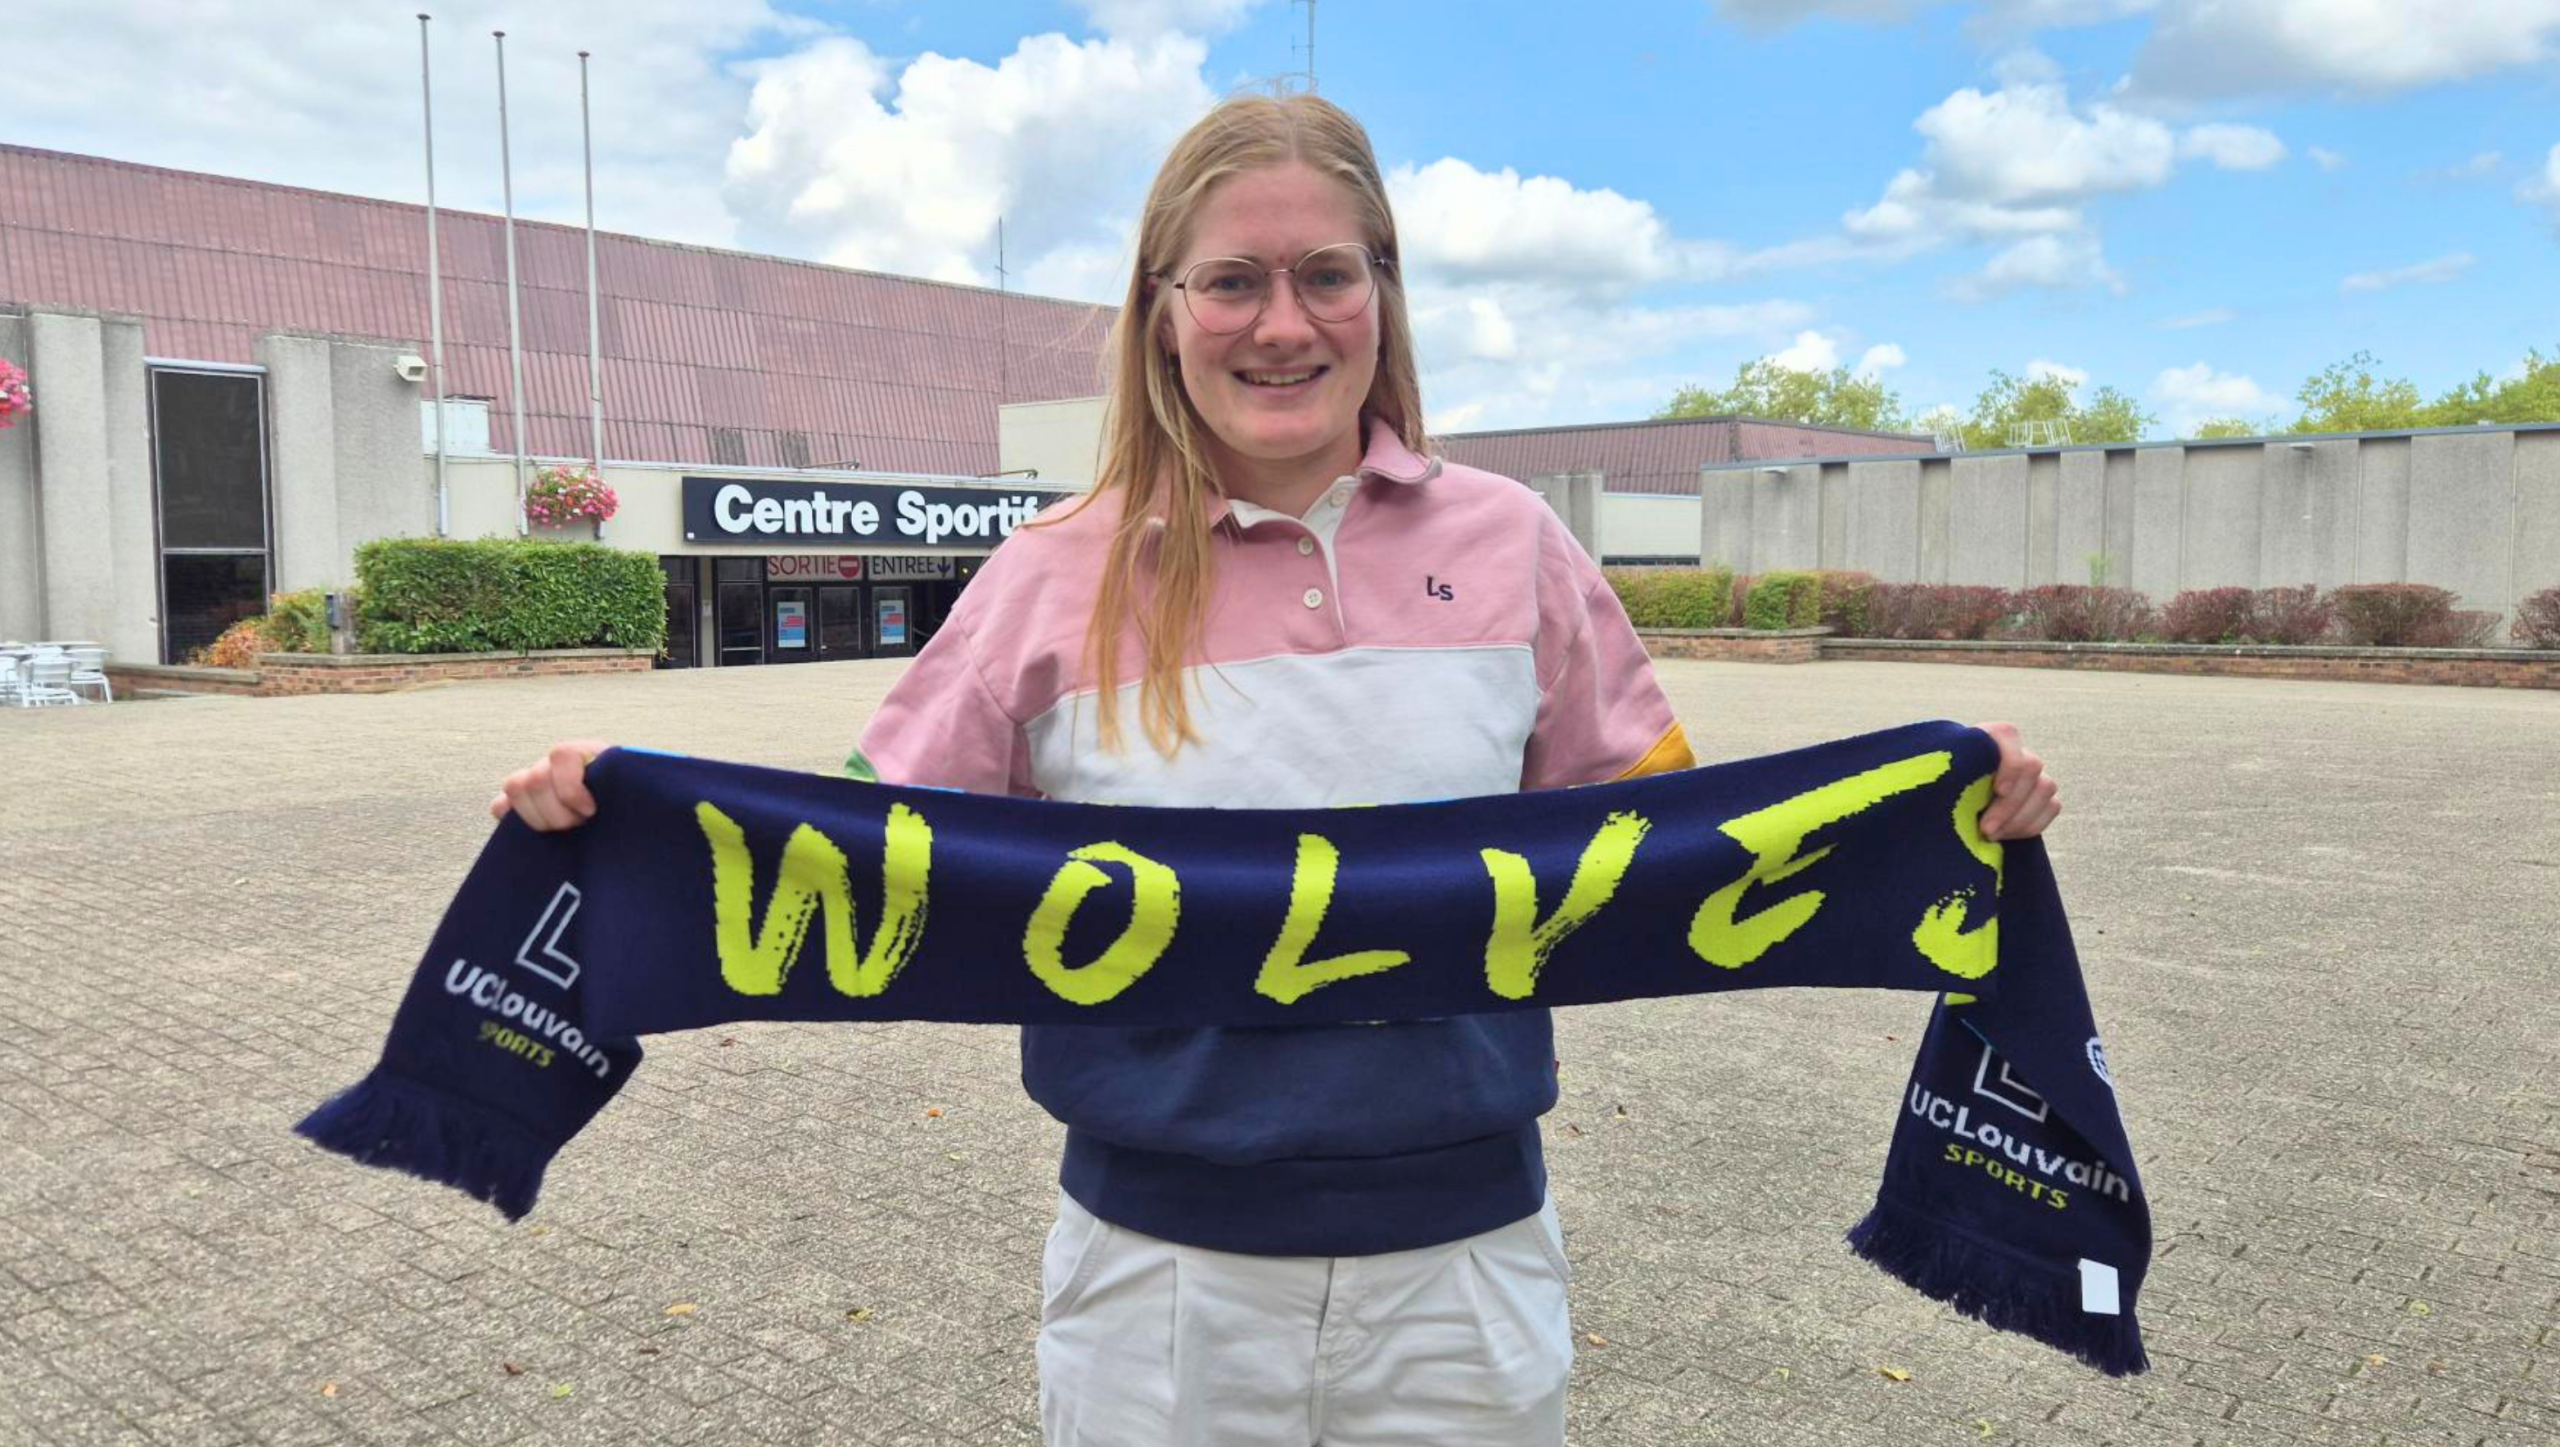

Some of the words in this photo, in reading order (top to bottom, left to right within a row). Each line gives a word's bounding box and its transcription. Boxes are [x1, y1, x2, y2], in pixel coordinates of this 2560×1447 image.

[714, 483, 879, 535] Centre
[896, 491, 1038, 543] Sportif
[768, 555, 837, 575] SORTIE
[1910, 1083, 2130, 1203] UCLouvain
[1944, 1142, 2070, 1210] SPORTS
